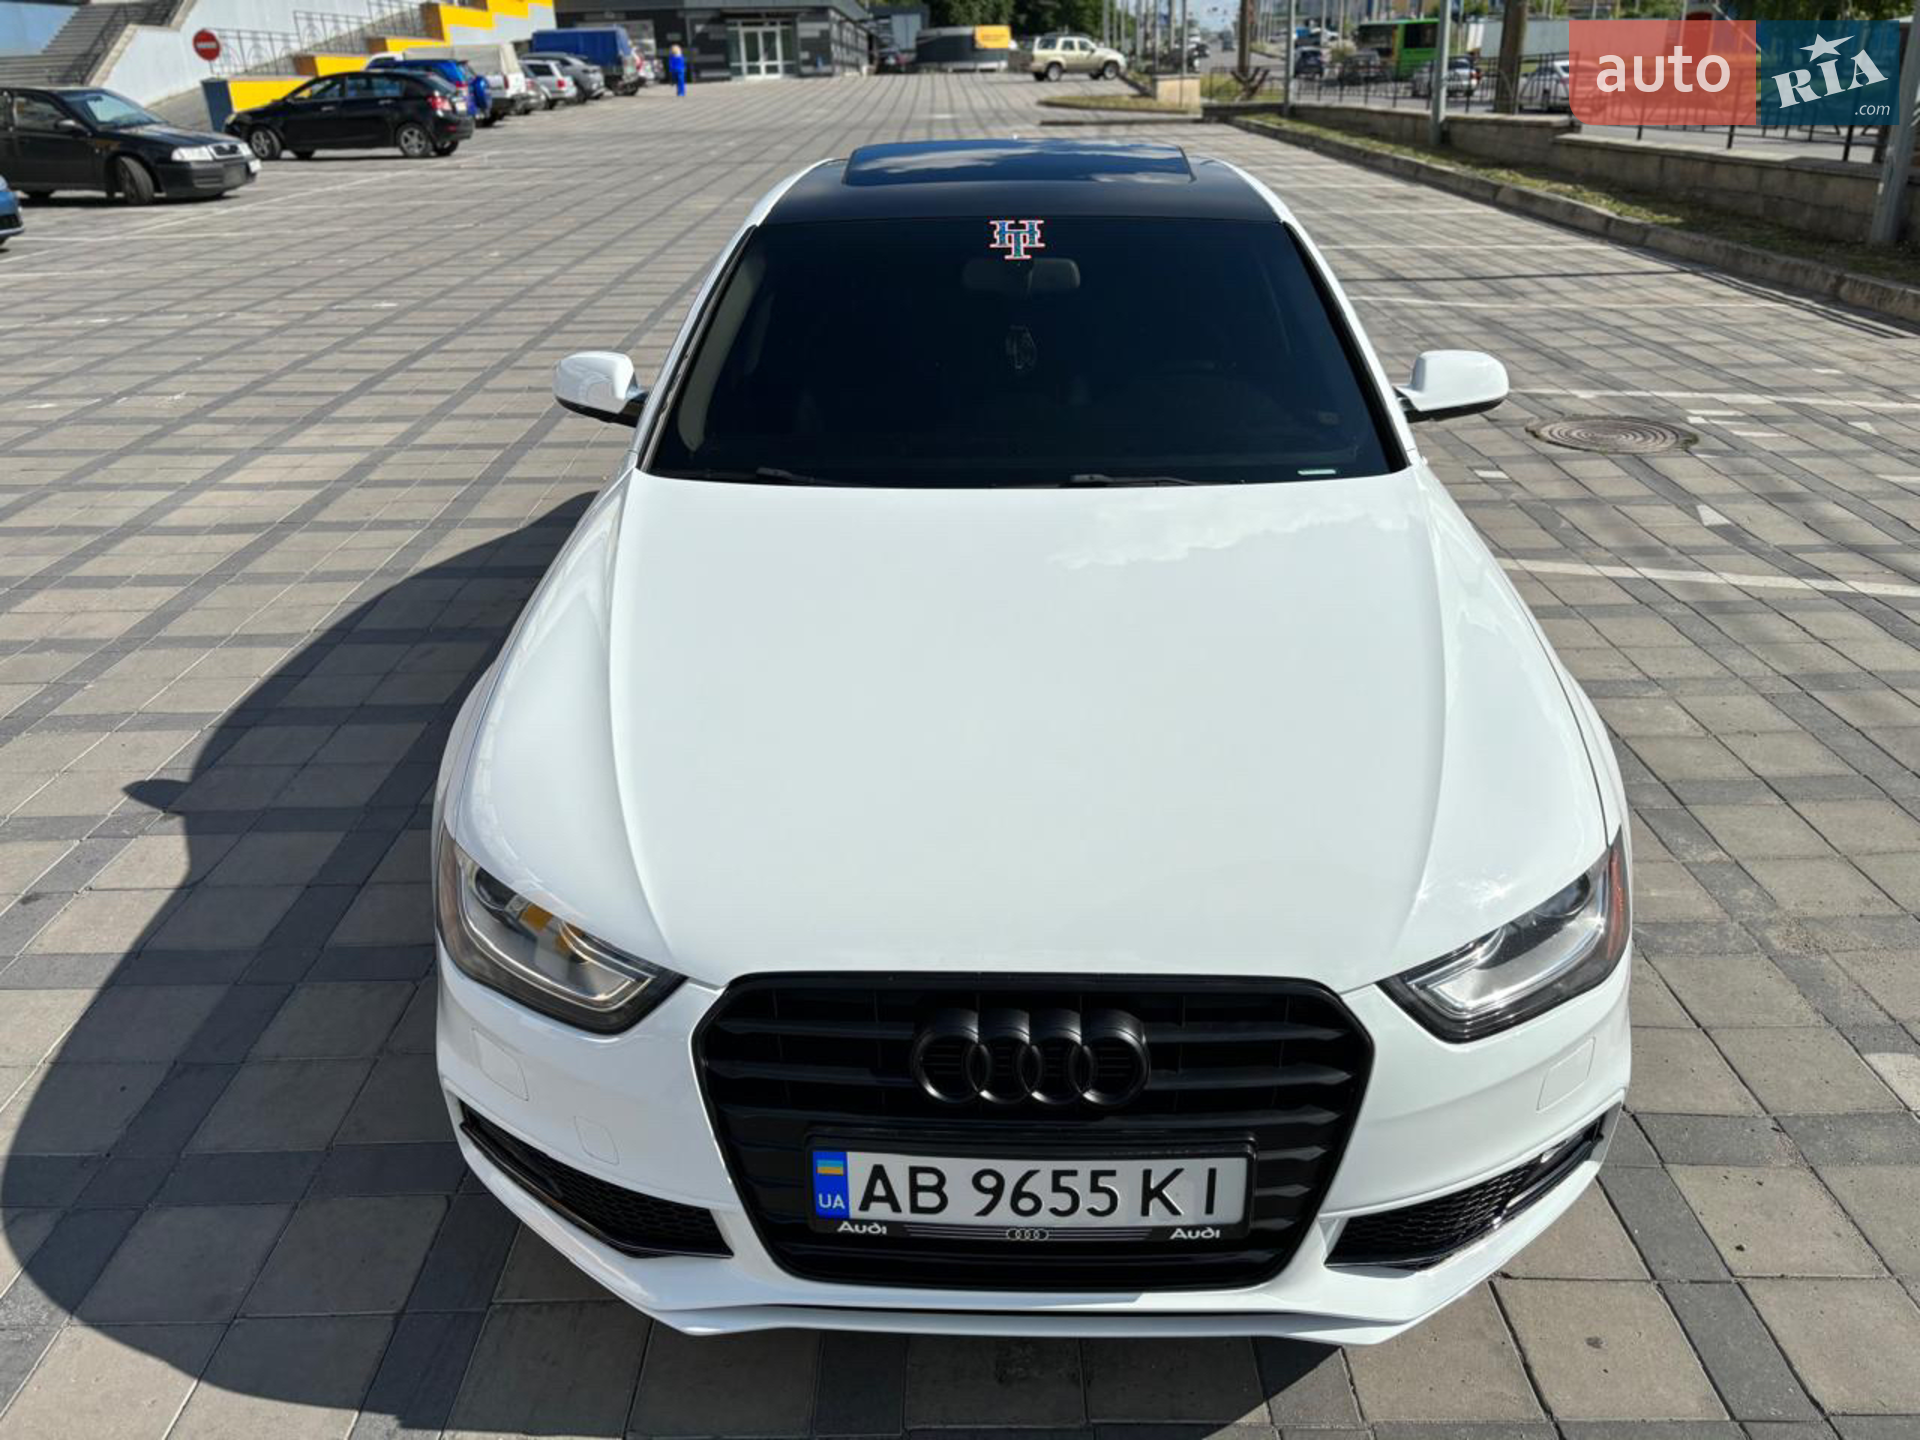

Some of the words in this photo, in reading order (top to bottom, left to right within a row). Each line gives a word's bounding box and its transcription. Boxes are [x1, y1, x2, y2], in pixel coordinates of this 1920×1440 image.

[858, 1163, 949, 1216] AB
[971, 1168, 1120, 1218] 9655
[818, 1193, 846, 1210] UA
[837, 1221, 888, 1236] Audi
[1170, 1226, 1221, 1241] Audi
